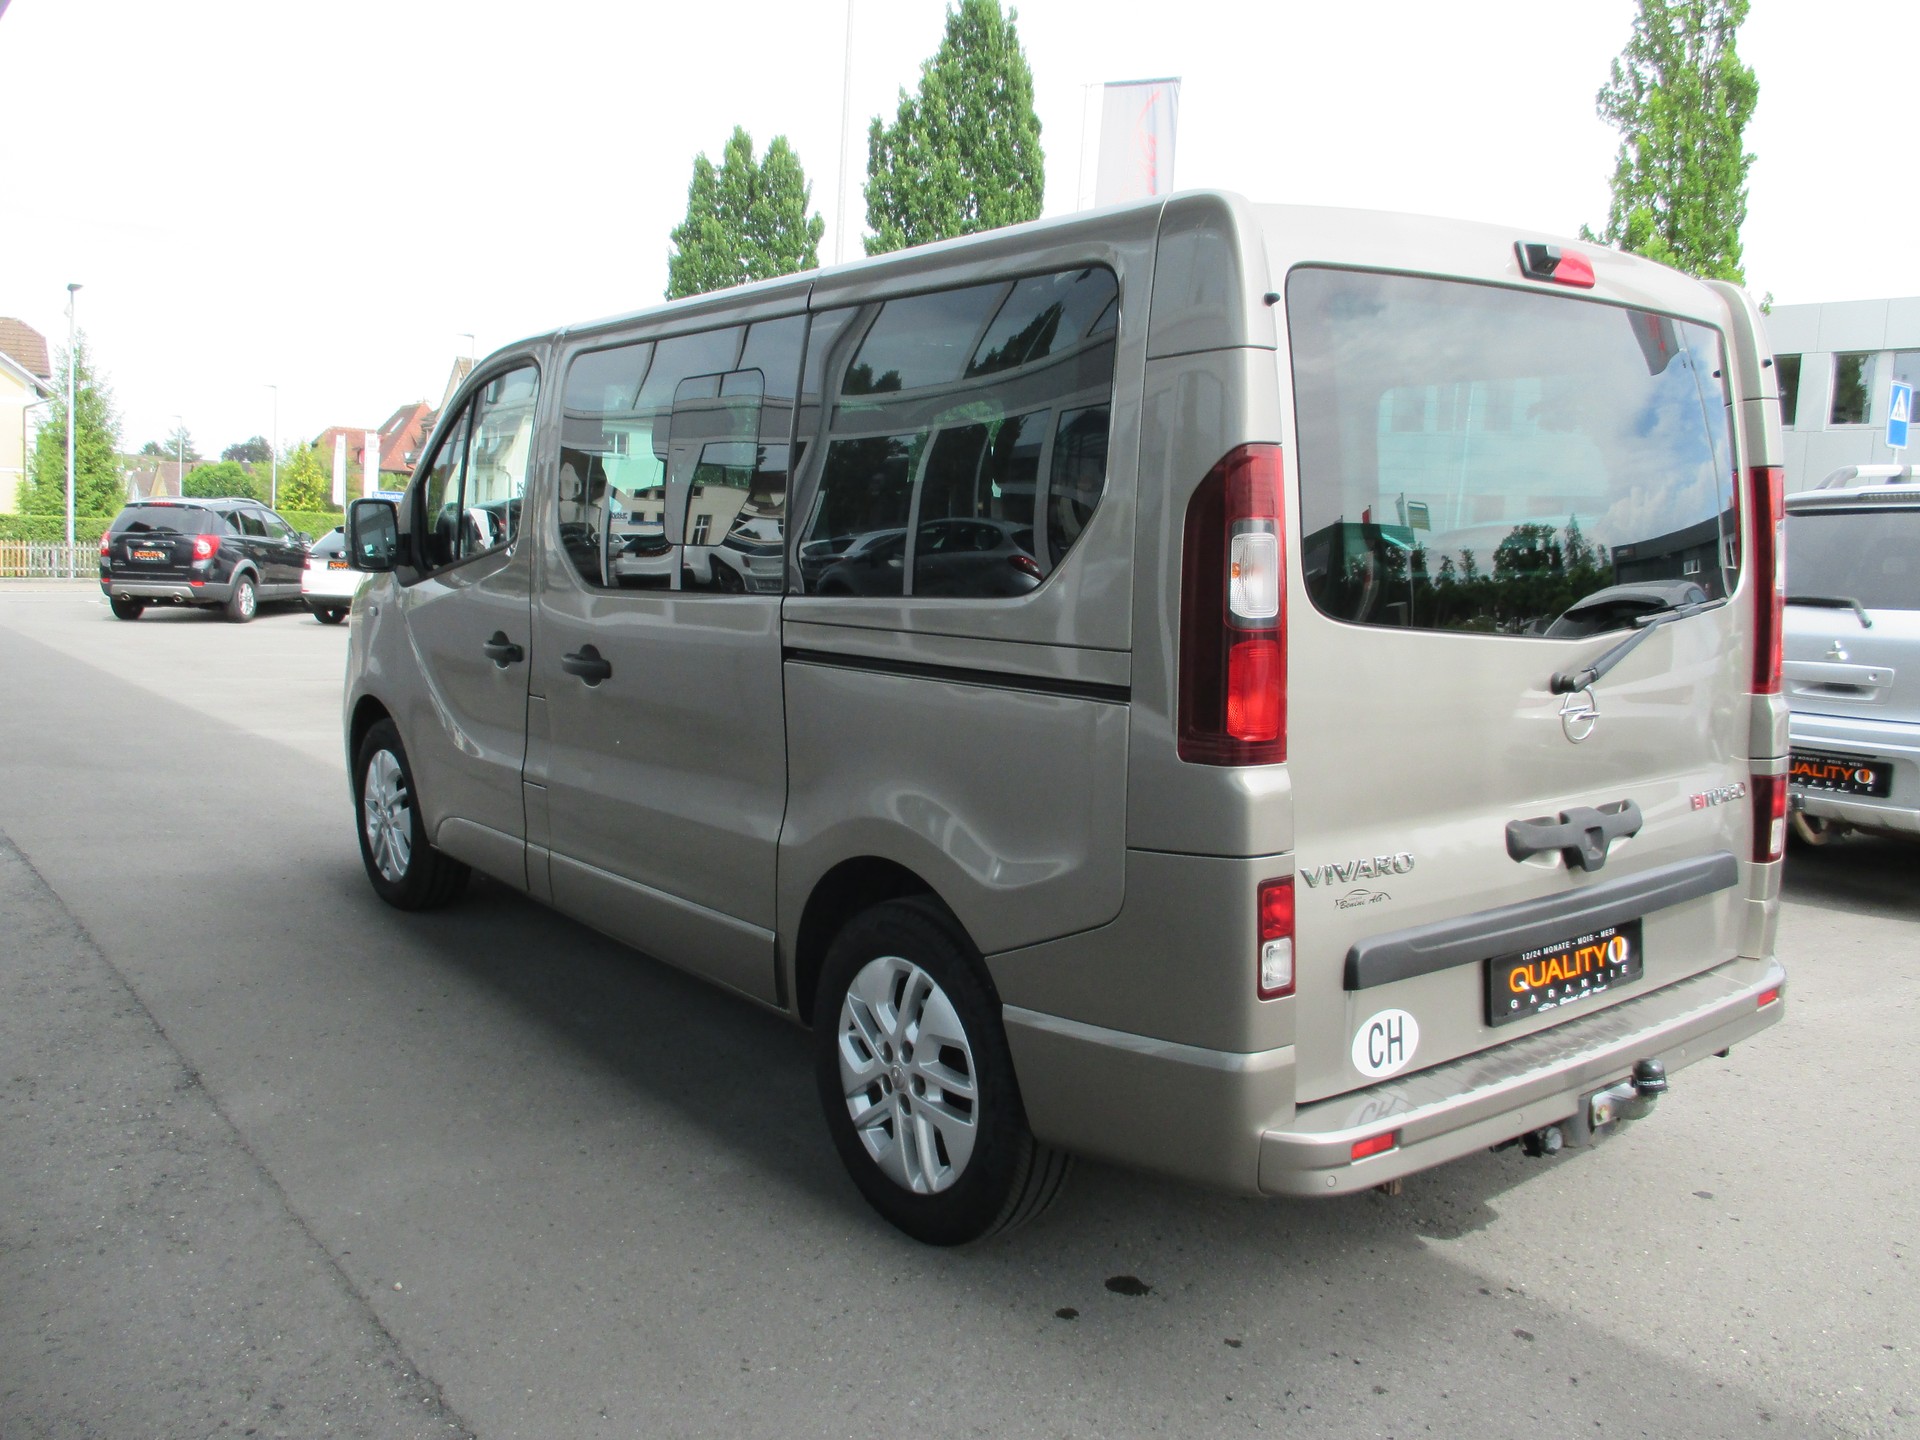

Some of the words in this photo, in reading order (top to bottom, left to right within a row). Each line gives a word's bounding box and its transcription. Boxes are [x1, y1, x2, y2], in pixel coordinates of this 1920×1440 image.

[1789, 761, 1854, 780] UALITY
[1300, 851, 1415, 888] VIVARO
[1521, 949, 1542, 961] 12/24
[1543, 941, 1570, 954] MONATE
[1577, 934, 1594, 945] MOIS
[1600, 927, 1616, 938] MESI
[1510, 964, 1628, 1009] GARANTIE
[1368, 1015, 1404, 1069] CH
